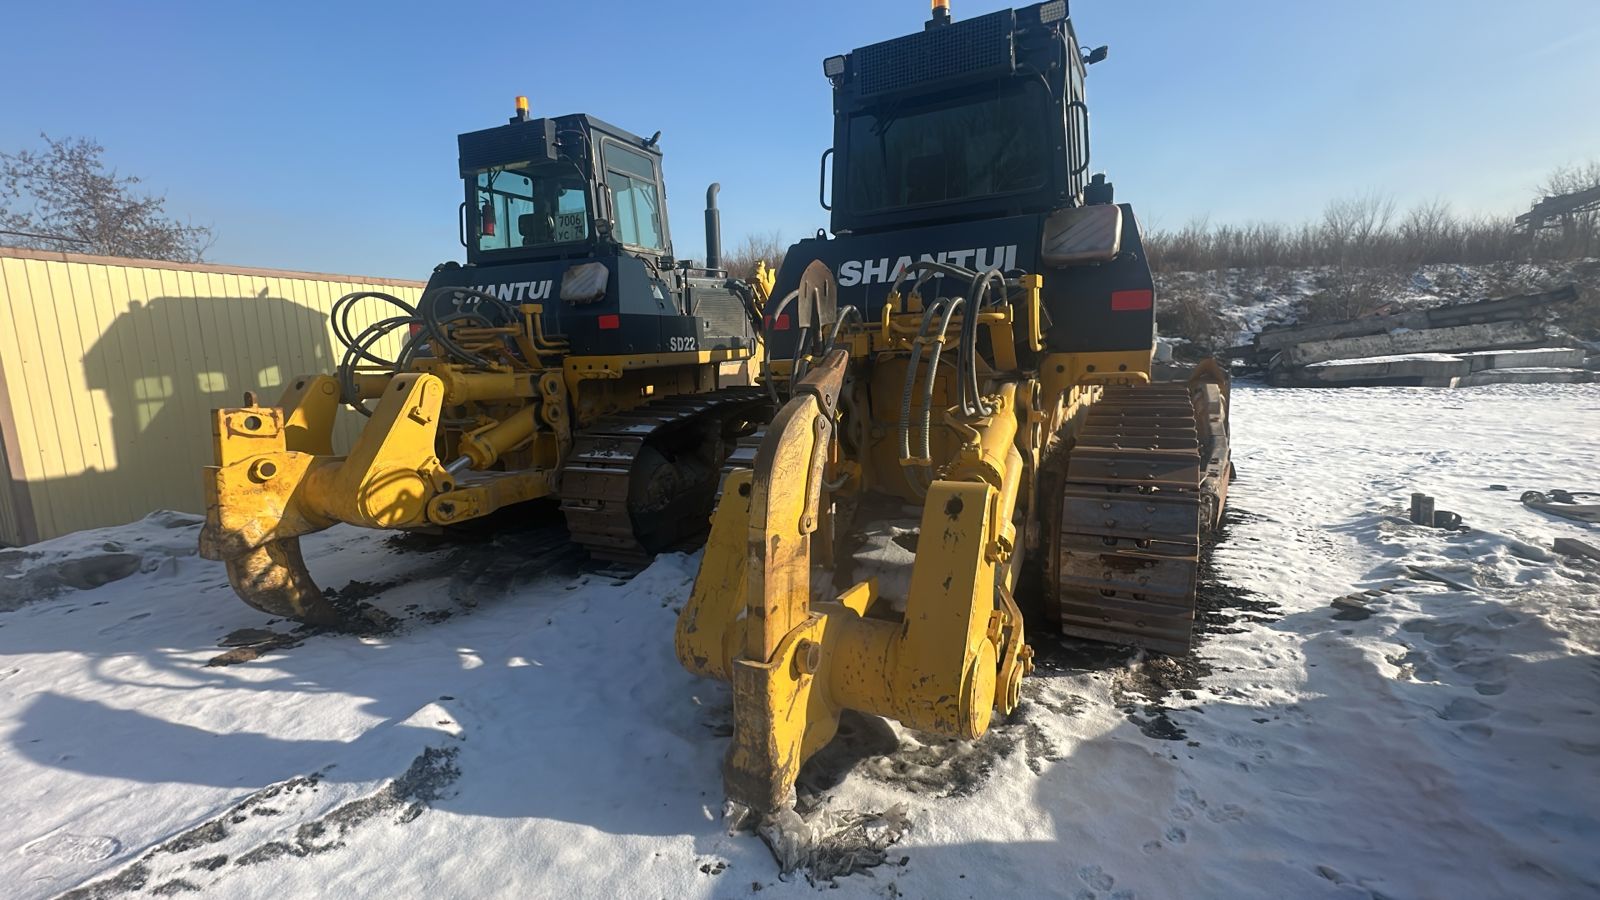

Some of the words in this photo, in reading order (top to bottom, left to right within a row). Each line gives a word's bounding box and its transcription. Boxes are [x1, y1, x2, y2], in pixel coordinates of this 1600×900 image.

[558, 214, 581, 227] 7006
[838, 245, 1017, 287] SHANTUI
[670, 336, 696, 352] SD22
